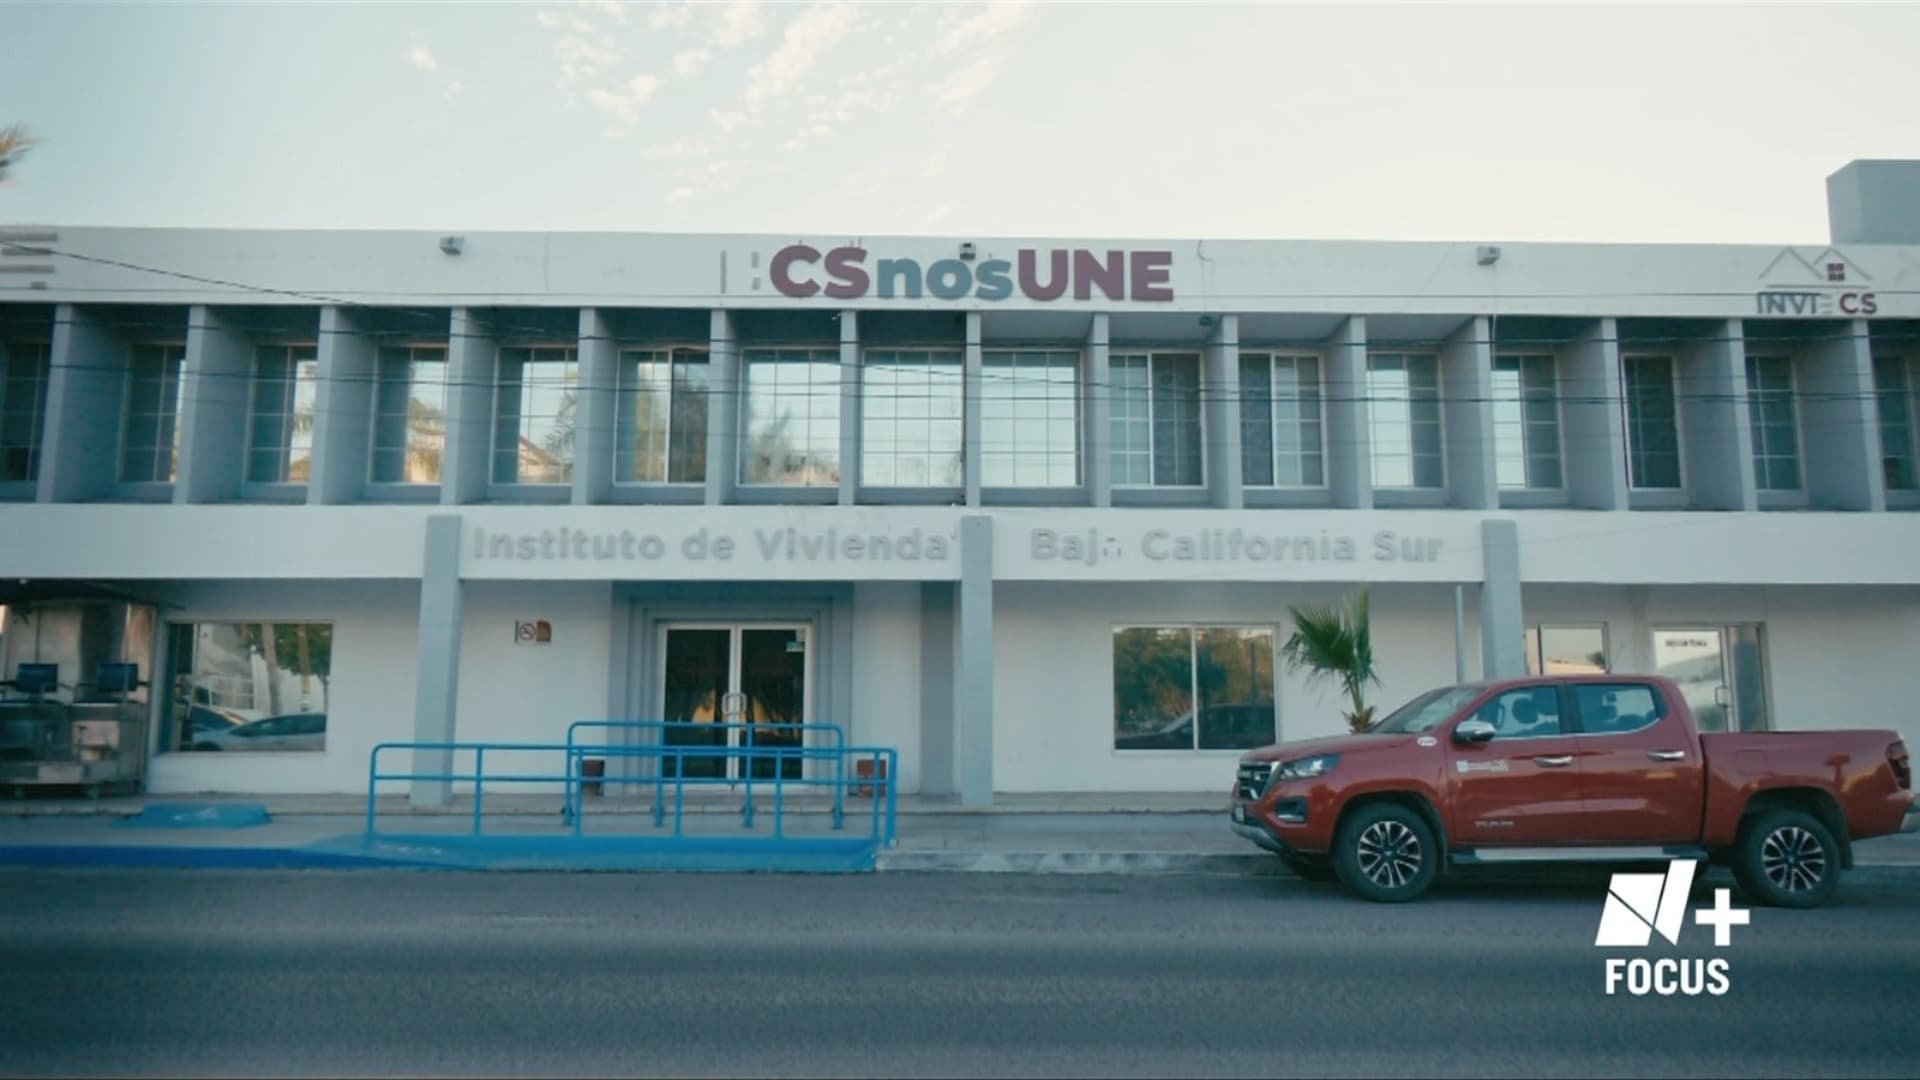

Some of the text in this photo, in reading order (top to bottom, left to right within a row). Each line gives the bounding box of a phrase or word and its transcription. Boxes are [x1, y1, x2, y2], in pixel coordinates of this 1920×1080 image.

[472, 527, 666, 561] Instituto
[682, 527, 737, 561] de
[755, 527, 950, 561] Vivienda
[1141, 528, 1356, 562] California
[1373, 530, 1445, 563] Sur
